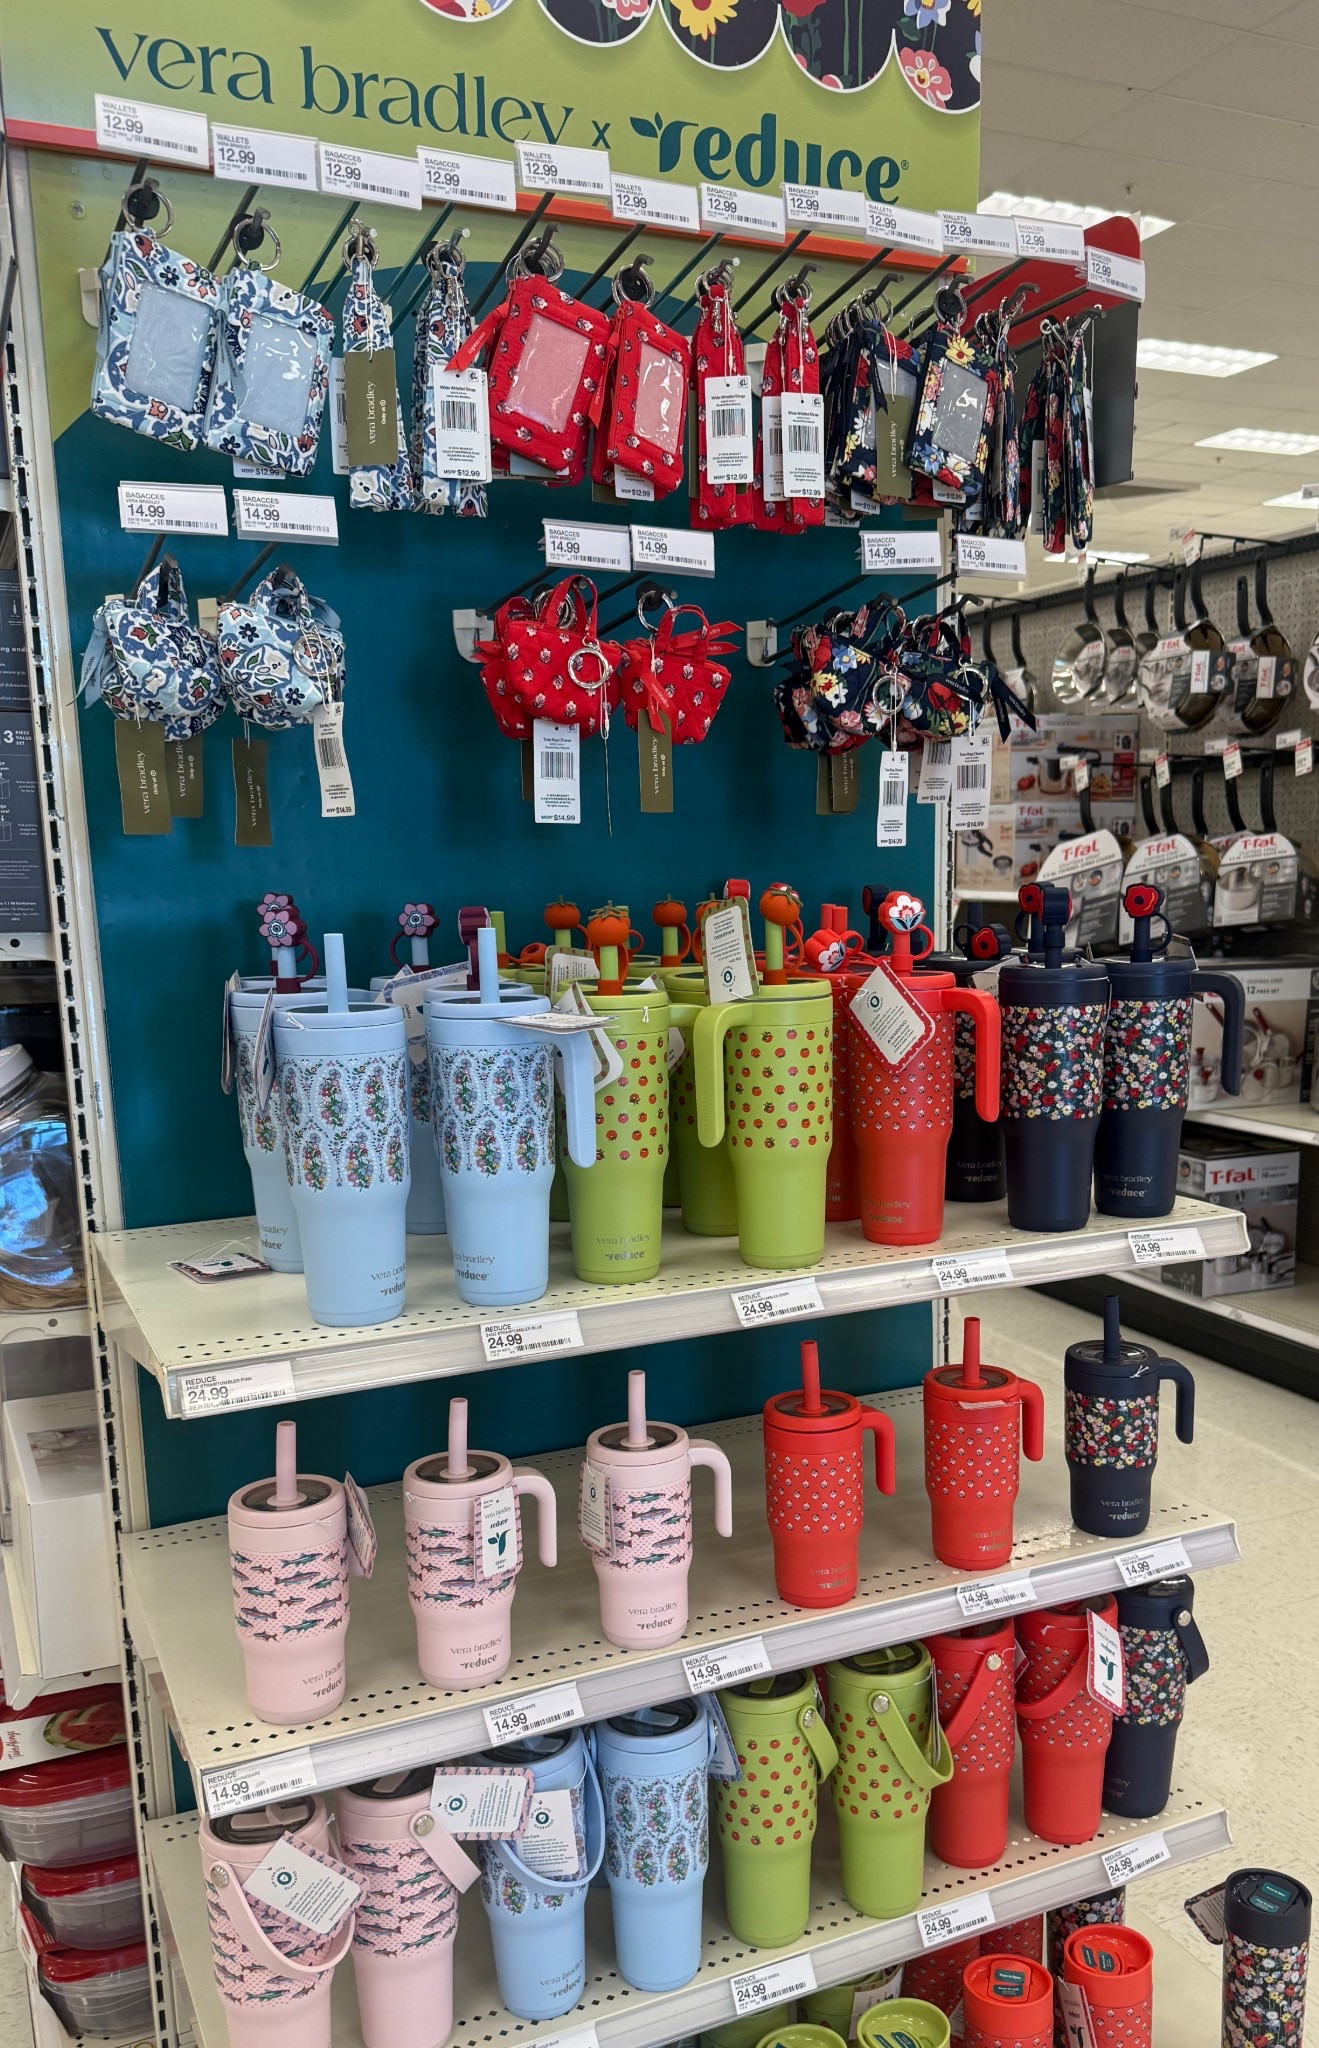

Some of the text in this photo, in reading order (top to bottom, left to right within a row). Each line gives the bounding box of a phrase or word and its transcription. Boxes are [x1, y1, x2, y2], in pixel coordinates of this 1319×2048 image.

[95, 26, 274, 105] vera
[300, 45, 574, 145] bradley
[591, 120, 611, 149] x
[102, 101, 137, 114] WALLETS
[104, 115, 143, 133] 12.99
[217, 133, 249, 145] WALLETS
[219, 147, 255, 164] 12.99
[325, 150, 361, 163] BAGACCES
[523, 151, 551, 160] WALLETS
[425, 158, 460, 169] BAGACCES
[525, 162, 558, 177] 12.99
[326, 162, 361, 180] 12.99
[426, 170, 460, 187] 12.99
[614, 182, 642, 192] WALLETS
[707, 187, 737, 197] BAGACCES
[788, 187, 819, 196] BAGACCES
[616, 194, 647, 209] 12.99
[708, 197, 737, 213] 12.99
[790, 197, 819, 211] 12.99
[868, 203, 892, 213] WALLETS
[869, 214, 897, 229] 12.99
[943, 213, 967, 222] WALLETS
[944, 224, 972, 237] 12.99
[1020, 234, 1045, 246] 12.99
[1091, 262, 1112, 277] 12.99
[367, 381, 376, 419] bradley
[890, 420, 898, 457] bradley
[255, 468, 280, 476] $12.99
[457, 469, 480, 477] $12.99
[125, 491, 165, 501] BAGACCES
[242, 495, 280, 504] BAGACCES
[631, 489, 651, 497] $12.99
[127, 504, 165, 518] 14.99
[244, 507, 280, 521] 14.99
[549, 528, 580, 537] BAGACCES
[637, 529, 668, 538] BAGACCES
[550, 540, 580, 554] 14.99
[639, 540, 668, 554] 14.99
[960, 538, 986, 547] BAGACCES
[868, 547, 896, 559] 14.99
[962, 550, 986, 561] 14.99
[954, 682, 970, 694] bradley
[3, 730, 14, 744] 3
[176, 741, 185, 775] bradle
[138, 750, 147, 789] bradley
[247, 767, 256, 804] bradley
[335, 806, 352, 814] $14.99
[1145, 839, 1177, 856] T-fal
[1241, 837, 1276, 849] T-fal
[1062, 839, 1099, 861] T-fal
[1247, 985, 1256, 995] 12
[964, 1174, 998, 1183] reduce
[1121, 1174, 1153, 1185] bradley
[1209, 1167, 1256, 1185] T-fal
[1108, 1187, 1147, 1198] reduce
[262, 1226, 288, 1236] bradley
[596, 1237, 618, 1246] vera
[1134, 1243, 1161, 1254] 24.99
[935, 1259, 957, 1267] REDUCE
[371, 1263, 406, 1281] vera brad
[457, 1269, 490, 1281] reduce
[939, 1268, 967, 1281] 24.99
[737, 1291, 761, 1302] REDUCE
[742, 1300, 773, 1316] 24.99
[485, 1323, 512, 1333] REDUCE
[488, 1334, 523, 1349] 24.99
[185, 1375, 217, 1386] REDUCE
[187, 1386, 229, 1404] 24.99
[1101, 1499, 1121, 1508] vera
[485, 1506, 512, 1520] vera bradley
[1108, 1510, 1141, 1521] reduce
[490, 1519, 509, 1529] reduce
[1125, 1560, 1150, 1576] 14.99
[960, 1583, 981, 1591] REDUCE
[961, 1590, 988, 1603] 14.99
[628, 1600, 678, 1615] vera bradley
[637, 1617, 675, 1631] reduce
[450, 1636, 503, 1656] vera bradley
[460, 1653, 499, 1670] reduce
[685, 1654, 709, 1666] REDUCE
[690, 1663, 720, 1682] 14.99
[302, 1672, 323, 1687] vera
[313, 1676, 344, 1698] reduce
[489, 1703, 516, 1717] REDUCE
[491, 1711, 512, 1722] PORTABLE
[493, 1712, 528, 1733] 14.99
[207, 1771, 238, 1785] REDUCE
[209, 1770, 261, 1788] PORTABLE DRINKWARE
[211, 1781, 249, 1801] 14.99
[1104, 1850, 1122, 1862] REDUCE
[1109, 1857, 1132, 1876] 24.99
[921, 1909, 942, 1920] REDUCE
[925, 1917, 951, 1936] 24.99
[733, 1973, 756, 1986] REDUCE
[548, 1976, 582, 1998] reduce
[737, 1983, 766, 2002] 24.99
